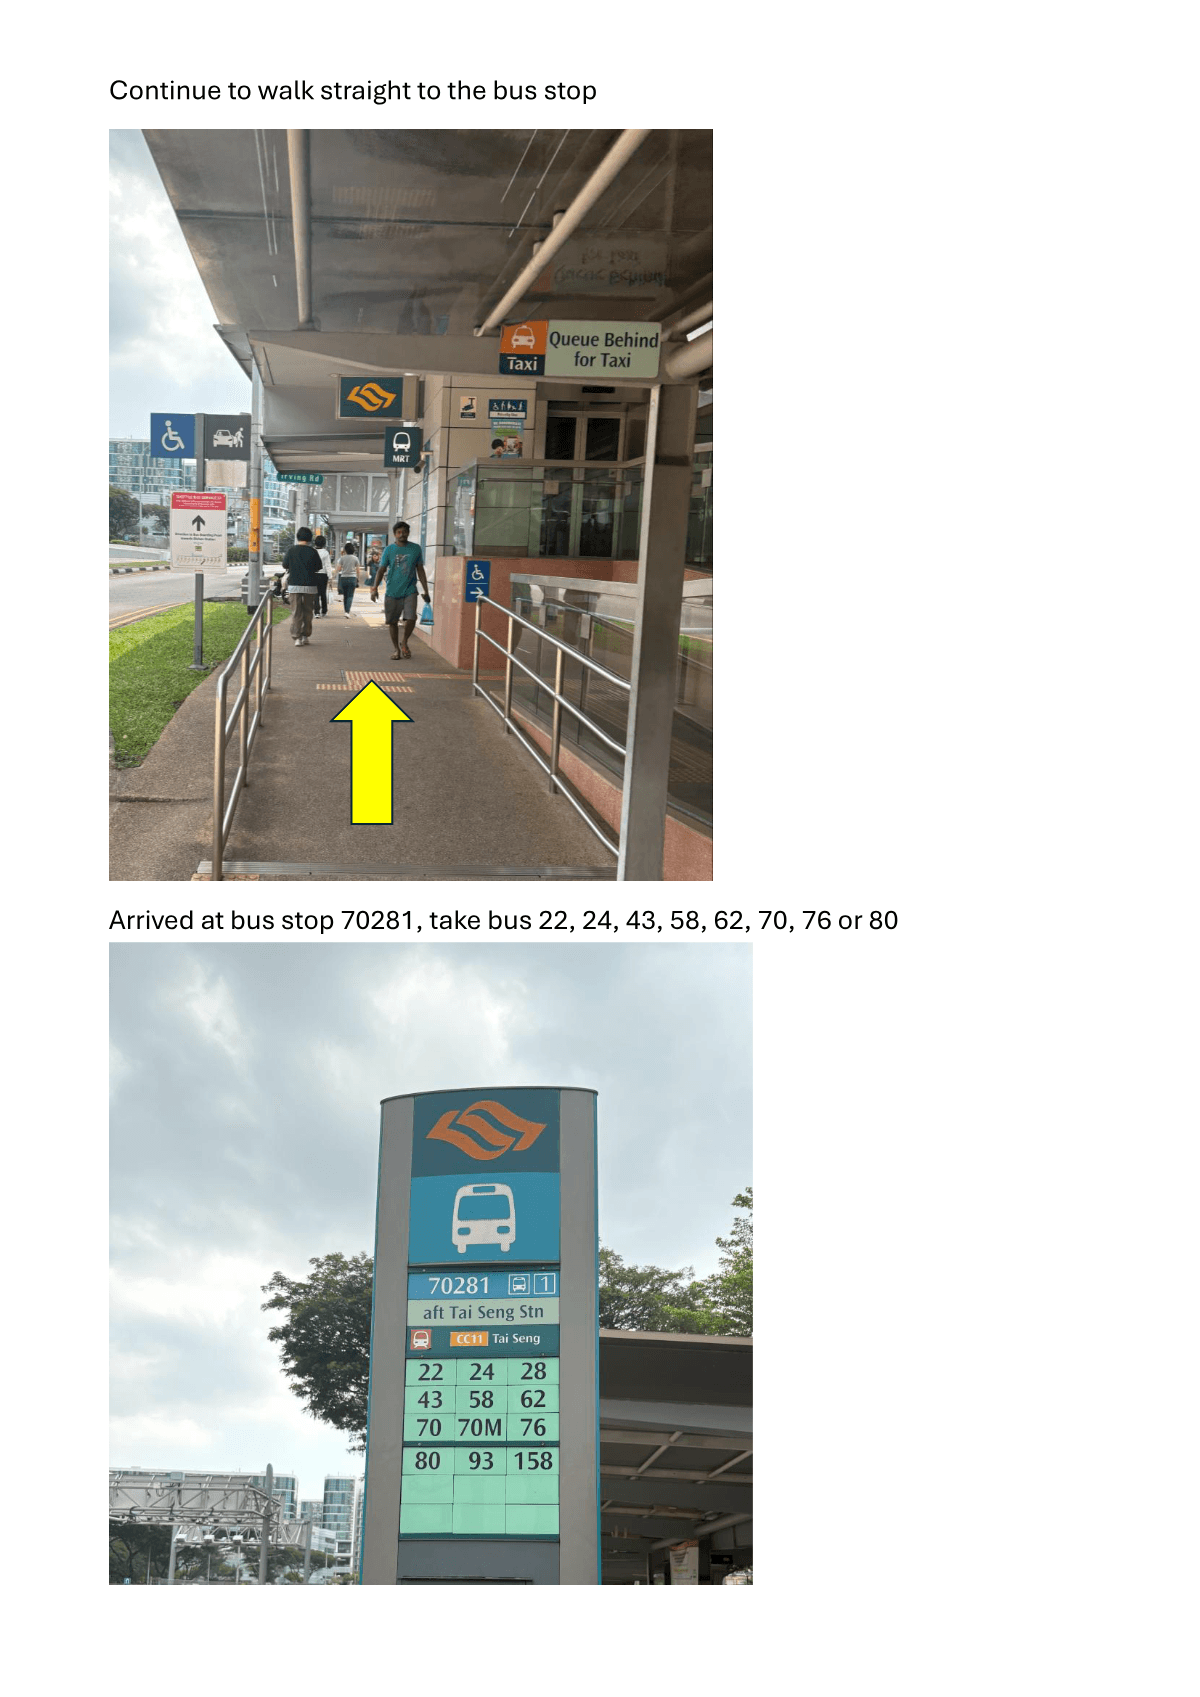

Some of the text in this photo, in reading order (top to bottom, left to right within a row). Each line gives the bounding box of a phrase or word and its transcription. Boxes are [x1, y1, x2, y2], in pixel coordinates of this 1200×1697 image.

[550, 331, 659, 348] Queue Behind
[507, 356, 538, 371] Taxi
[574, 351, 631, 367] for Taxi
[428, 1276, 548, 1294] 70281 1
[423, 1305, 544, 1321] aft Tai Seng Stn
[456, 1333, 540, 1345] CC11 Tai Seng
[418, 1362, 546, 1381] 22 24 28
[418, 1389, 546, 1408] 43 58 62
[416, 1418, 546, 1436] 70 70M 76
[415, 1451, 553, 1470] 80 93 158
